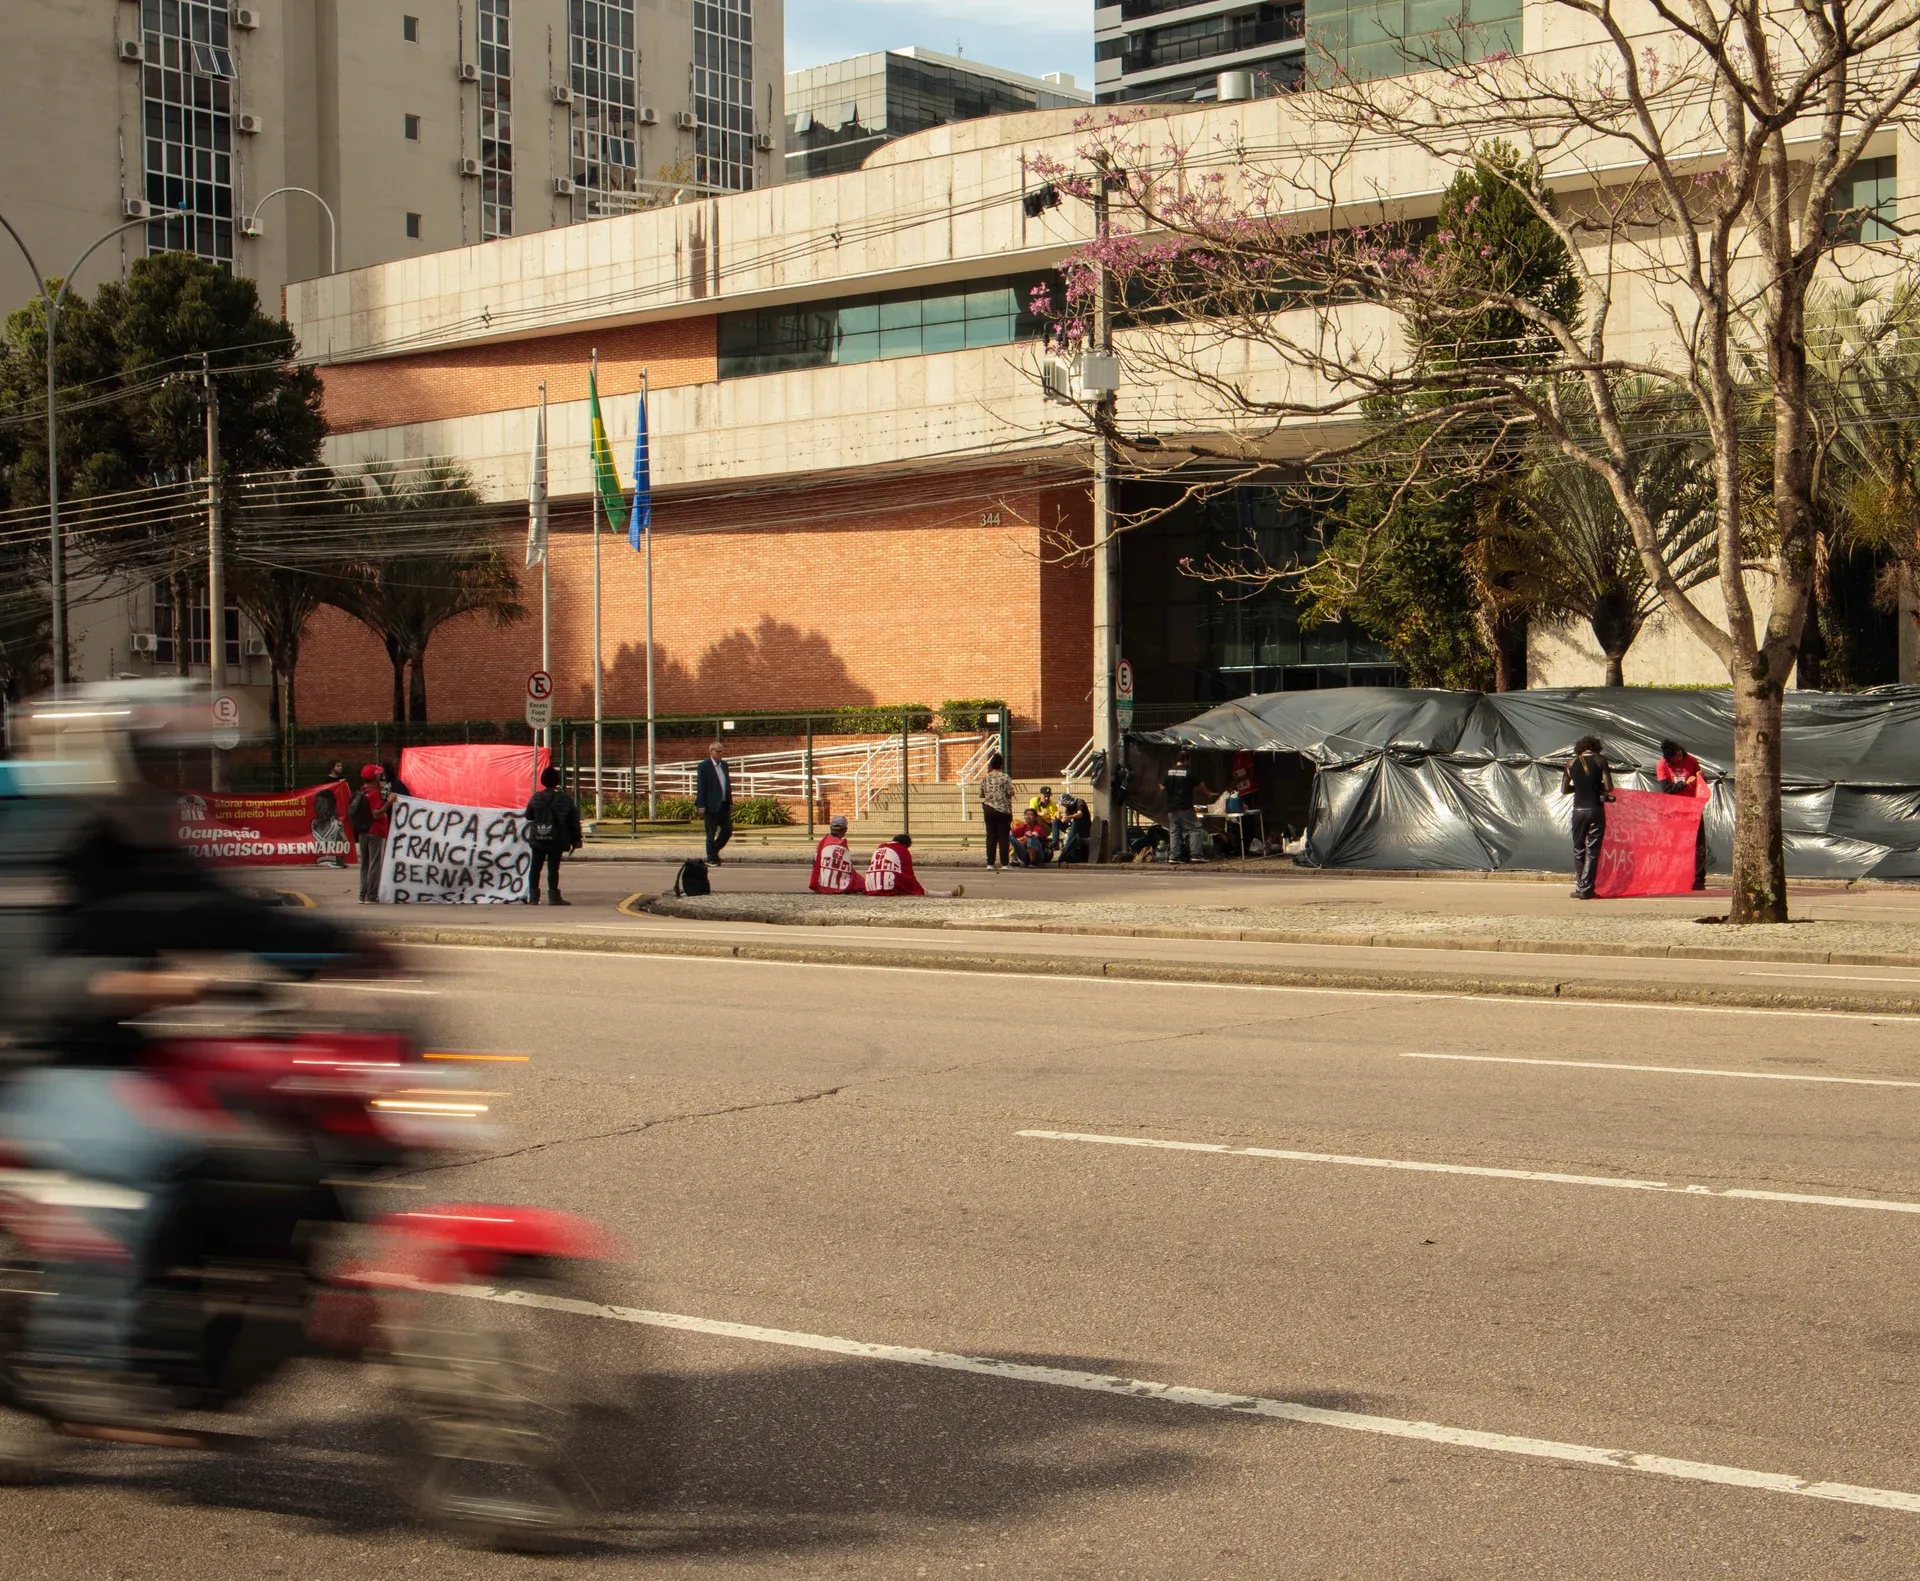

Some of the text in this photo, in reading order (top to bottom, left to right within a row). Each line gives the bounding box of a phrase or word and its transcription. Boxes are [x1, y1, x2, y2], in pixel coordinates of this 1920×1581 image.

[979, 512, 1001, 527] 344
[1121, 667, 1127, 685] E
[535, 677, 544, 693] E
[220, 702, 229, 716] E
[215, 799, 244, 808] Morar
[245, 798, 300, 809] dignamente
[181, 809, 206, 821] MLB
[215, 807, 306, 819] um direito humano!
[178, 826, 260, 841] Ocupação
[179, 840, 351, 858] RANCISCO BERNARDO
[1602, 849, 1634, 874] MAS
[393, 862, 524, 894] BERNARDO
[819, 868, 850, 889] MLB
[864, 870, 896, 892] MLB
